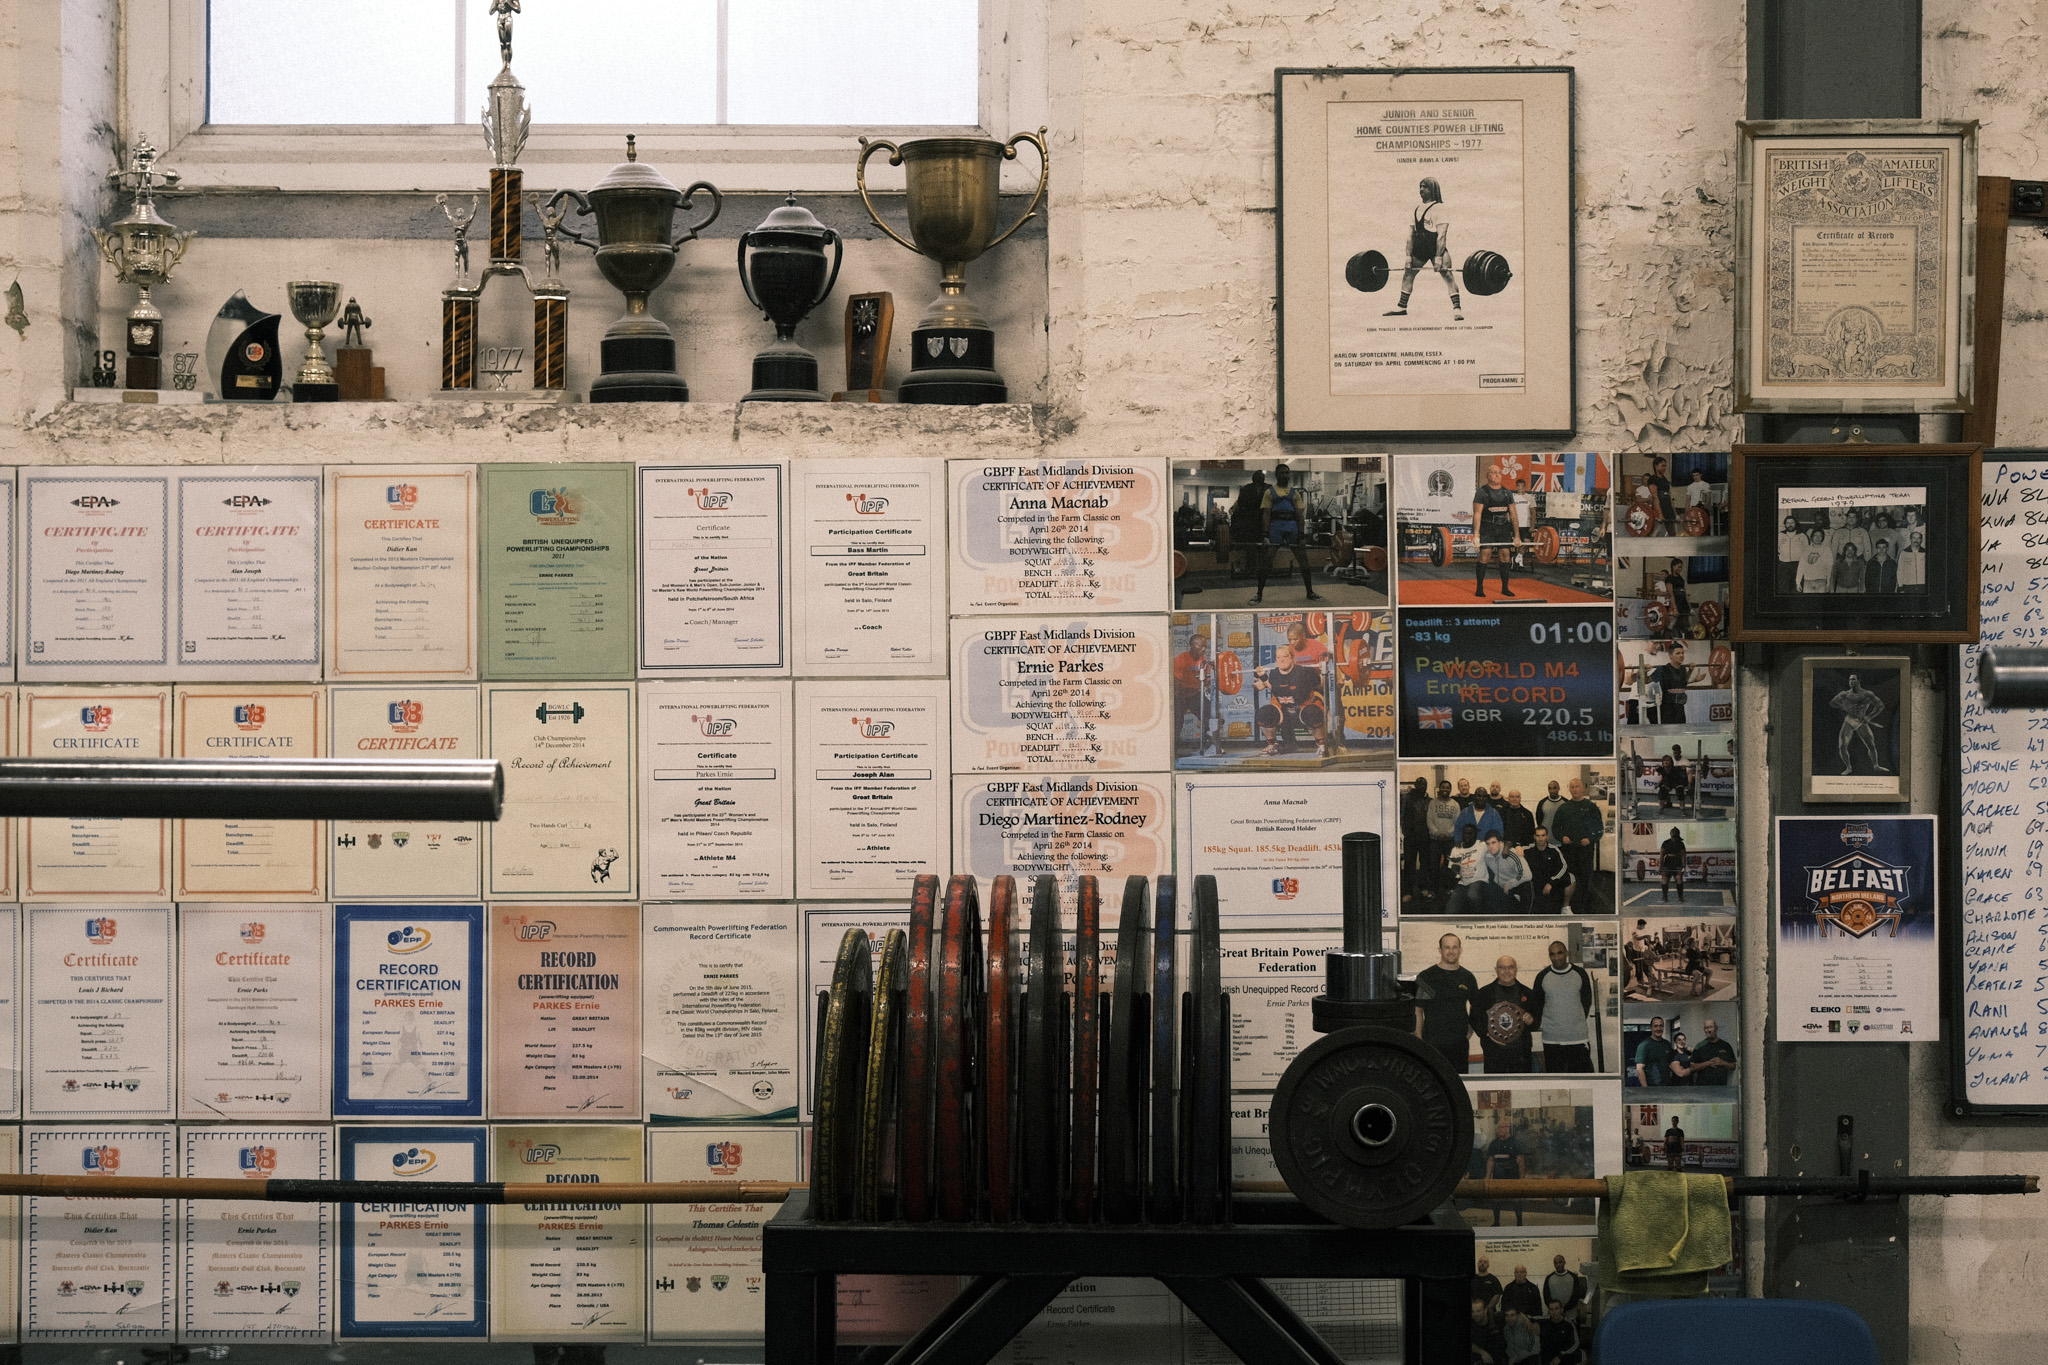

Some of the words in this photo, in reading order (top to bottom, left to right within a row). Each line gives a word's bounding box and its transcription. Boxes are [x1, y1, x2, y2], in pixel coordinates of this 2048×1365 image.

[1383, 110, 1416, 119] JUNIOR
[1420, 110, 1439, 118] AND
[1442, 109, 1474, 118] SENIOR
[1357, 126, 1382, 135] HOME
[1386, 125, 1430, 134] COUNTIES
[1434, 124, 1466, 133] POWER
[1470, 123, 1504, 133] LIFTING
[1376, 140, 1451, 150] CHAMPIONSHIPS
[1461, 139, 1482, 148] 1977
[1779, 160, 1828, 170] BRITISH
[1883, 159, 1936, 170] AMATEUR
[1779, 177, 1828, 197] WEIGHT
[1884, 177, 1934, 197] LIFTERS
[1818, 197, 1894, 218] ASSOCIATION
[1816, 232, 1854, 240] Certificate
[480, 347, 524, 369] 1977
[983, 467, 1015, 477] GBPF
[1018, 466, 1040, 476] East
[1042, 465, 1089, 476] Midlands
[1092, 465, 1134, 475] Division
[983, 481, 1044, 491] CERTIFICATE
[1049, 481, 1060, 490] OF
[1063, 480, 1135, 490] ACHIEVEMENT
[703, 496, 728, 508] IPF
[1009, 497, 1047, 509] Anna
[1051, 495, 1108, 509] Macnab
[364, 519, 440, 529] CERTIFICATE
[1029, 526, 1049, 534] April
[1051, 525, 1066, 533] 26th
[1069, 525, 1089, 533] 2014
[44, 526, 148, 537] CERTIFICATE
[196, 526, 299, 537] CERTIFICATE
[1405, 618, 1443, 627] Deadlift
[1463, 618, 1500, 627] attempt
[1409, 632, 1431, 641] -83
[1435, 632, 1451, 643] kg
[1530, 621, 1612, 644] 01:00
[1018, 661, 1054, 673] Ernie
[1059, 660, 1104, 673] Parkes
[1443, 663, 1536, 679] WORLD
[1545, 662, 1579, 678] M4
[1460, 687, 1566, 703] RECORD
[1462, 709, 1502, 722] GBR
[1522, 708, 1594, 726] 220.5
[1547, 731, 1593, 742] 486.1
[53, 738, 139, 749] CERTIFICATE
[206, 737, 293, 748] CERTIFICATE
[358, 737, 458, 750] CERTIFICATE
[511, 757, 543, 770] Record
[558, 757, 613, 770] Achievement
[1962, 800, 2020, 817] RACHEL
[979, 814, 1020, 829] Diego
[1024, 813, 1147, 828] Martinez-Rodney
[1203, 846, 1226, 854] 185kg
[1255, 845, 1286, 854] 185.5kg
[1323, 844, 1343, 852] 453k
[1811, 869, 1904, 893] BELFAST
[1861, 892, 1885, 900] IRELAND
[1964, 909, 2036, 924] CHARLOTTE
[708, 924, 749, 932] Powerlifting
[215, 951, 291, 966] Certificate
[1220, 948, 1247, 958] Great
[1251, 948, 1289, 958] Britain
[64, 953, 139, 967] Certificate
[540, 952, 596, 967] RECORD
[379, 964, 439, 975] RECORD
[1259, 963, 1317, 973] Federation
[356, 980, 461, 991] CERTIFICATION
[518, 974, 619, 990] CERTIFICATION
[1966, 974, 2023, 992] BEATRIZ
[1243, 985, 1289, 997] Unequipped
[1291, 984, 1319, 993] Record
[374, 999, 416, 1008] PARKES
[418, 999, 443, 1008] Ernie
[533, 1002, 572, 1010] PARKES
[575, 1002, 600, 1010] Ernie
[1969, 1001, 2007, 1017] RANI
[380, 1221, 421, 1230] PARKES
[424, 1221, 449, 1229] Ernie
[538, 1223, 577, 1231] PARKES
[692, 1220, 724, 1229] Thomas
[727, 1220, 759, 1229] Celestin
